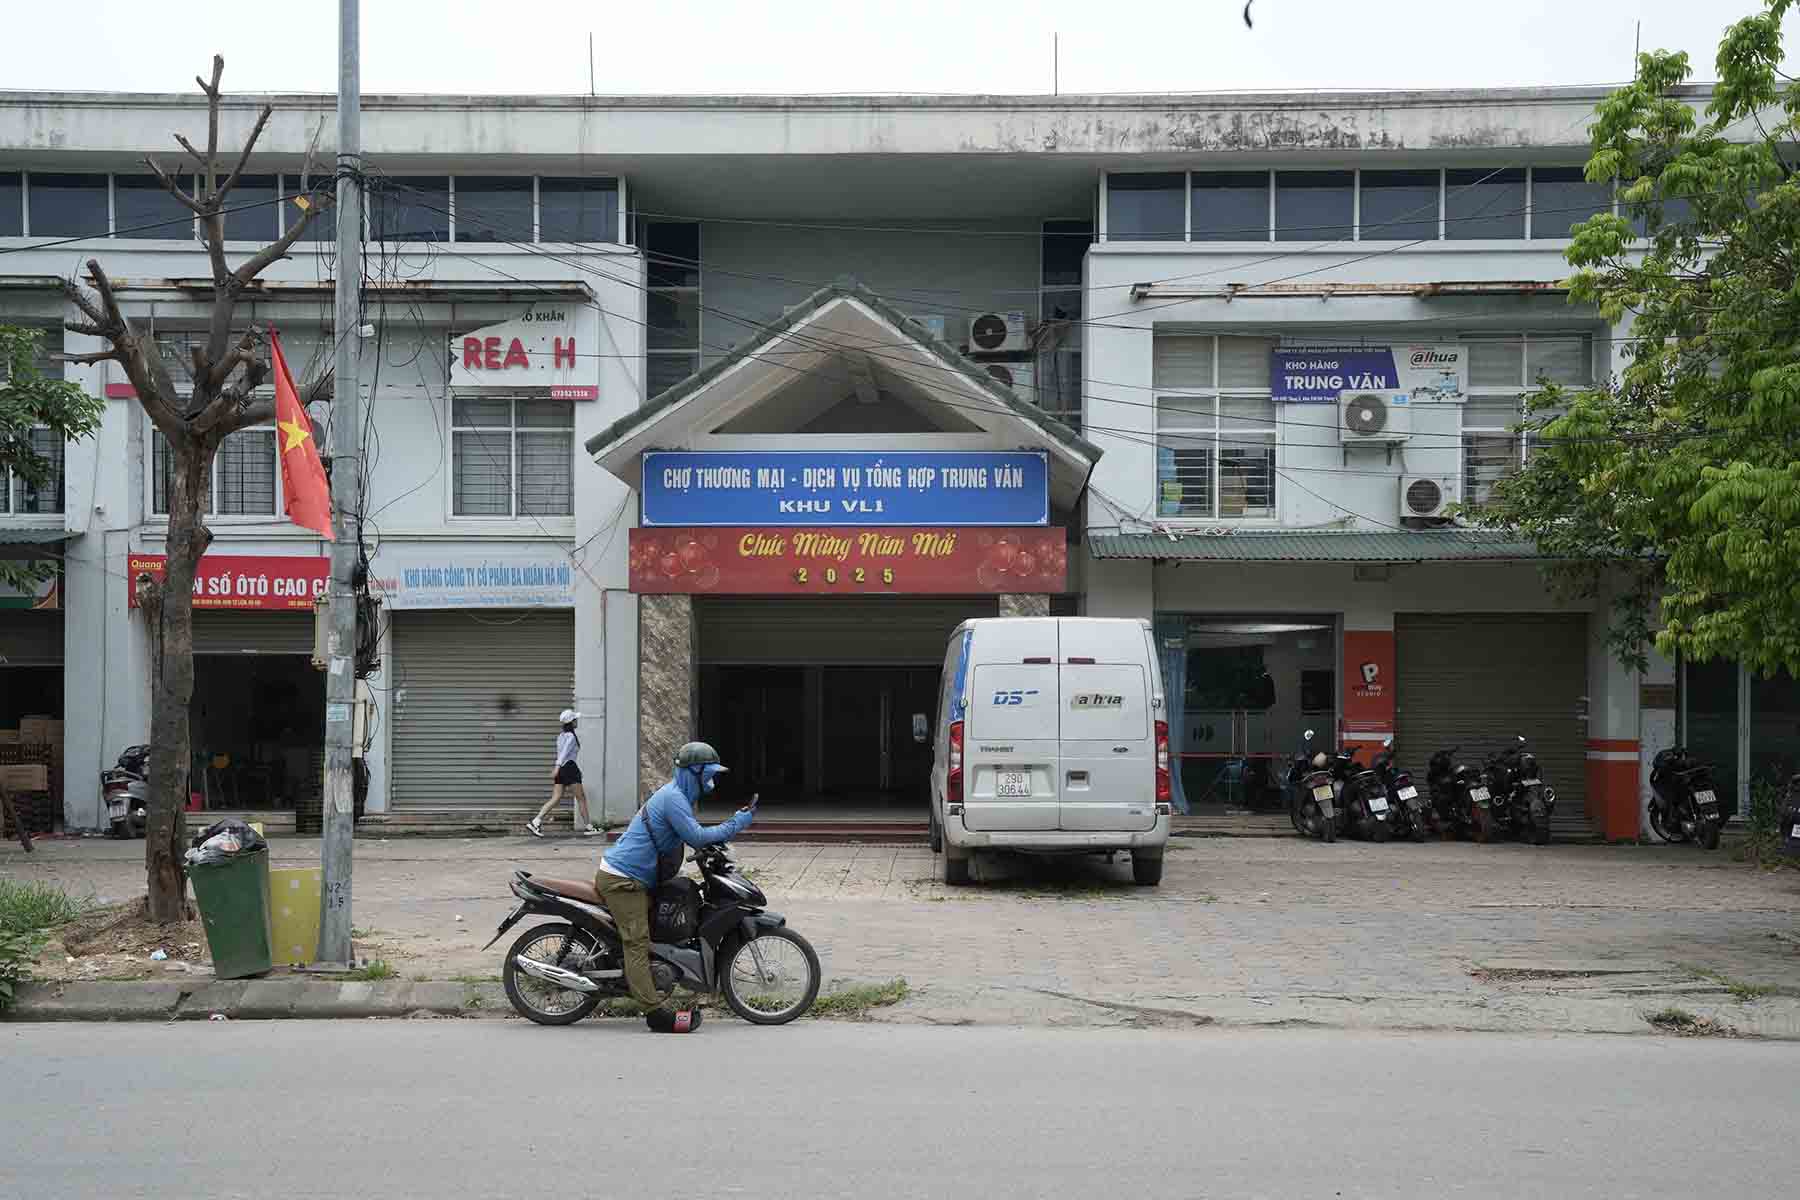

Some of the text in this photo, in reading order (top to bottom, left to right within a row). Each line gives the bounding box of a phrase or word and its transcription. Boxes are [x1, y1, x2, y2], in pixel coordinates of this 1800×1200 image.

[1285, 359, 1339, 370] KHO HÀNG
[1284, 371, 1386, 390] TRUNG VĂN
[663, 467, 692, 494] CHỢ
[696, 466, 751, 489] THƯƠNG
[757, 468, 785, 493] MẠI
[803, 468, 836, 493] DỊCH
[842, 468, 860, 493] VỤ
[865, 458, 902, 489] TỔNG
[908, 466, 936, 493] HỢP
[941, 467, 988, 489] TRUNG
[994, 464, 1023, 489] VĂN
[779, 500, 885, 513] KHU VL1
[738, 532, 958, 561] Chúc Mừng Năm Mới
[131, 559, 162, 570] Quang
[404, 568, 420, 587] KHO
[421, 565, 442, 587] HÀNG
[444, 563, 465, 587] CÔNG
[465, 568, 475, 587] TY
[477, 561, 488, 587] CỔ
[208, 571, 231, 596] SỐ
[236, 574, 268, 596] ÔTÔ
[273, 578, 307, 597] CAO
